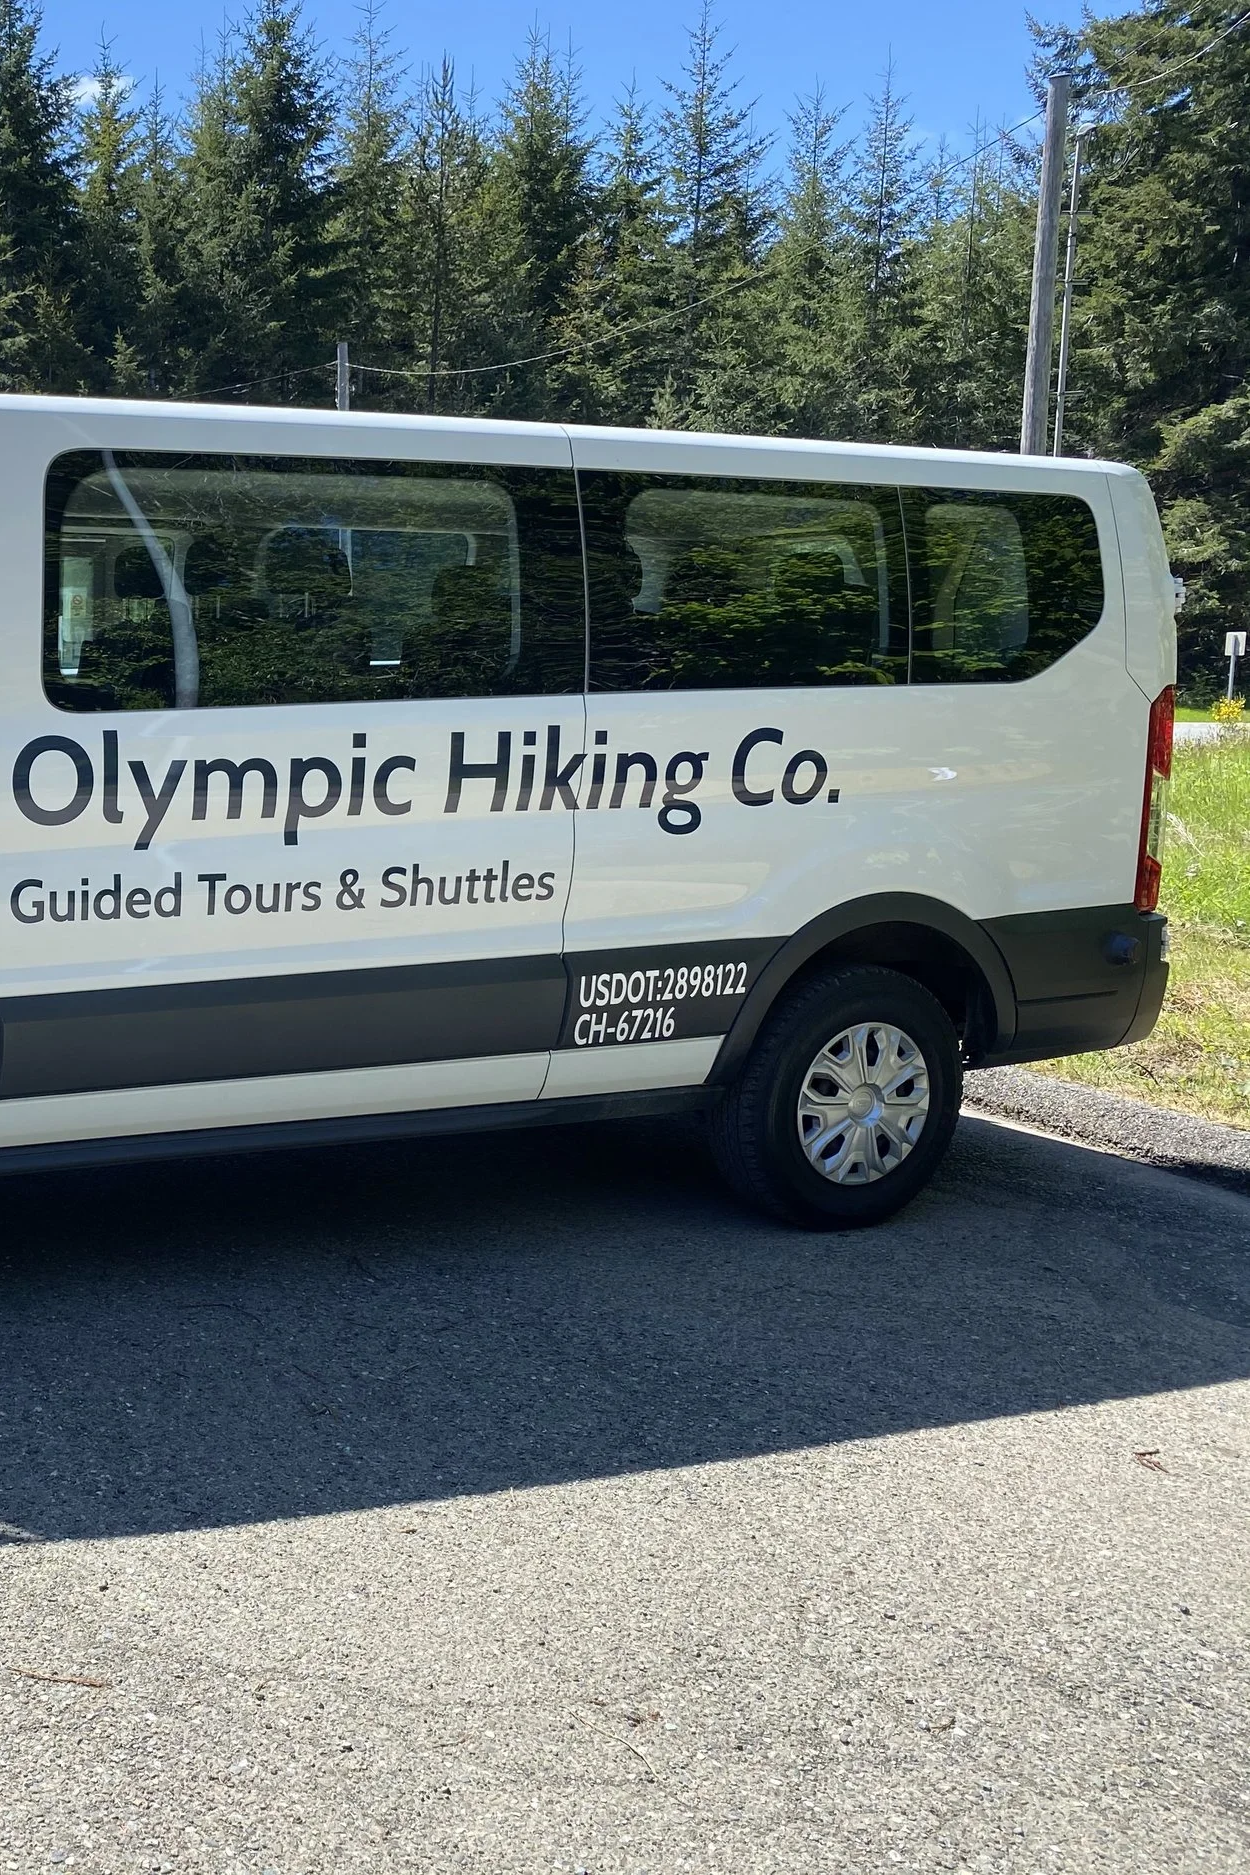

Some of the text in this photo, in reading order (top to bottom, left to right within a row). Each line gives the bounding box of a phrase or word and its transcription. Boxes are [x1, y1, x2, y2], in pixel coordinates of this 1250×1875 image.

[12, 725, 841, 851] Olympic Hiking Co.
[10, 859, 556, 924] Guided Tours & Shuttles
[579, 961, 748, 1008] USDOT:2898122
[573, 1006, 676, 1046] CH-67216
